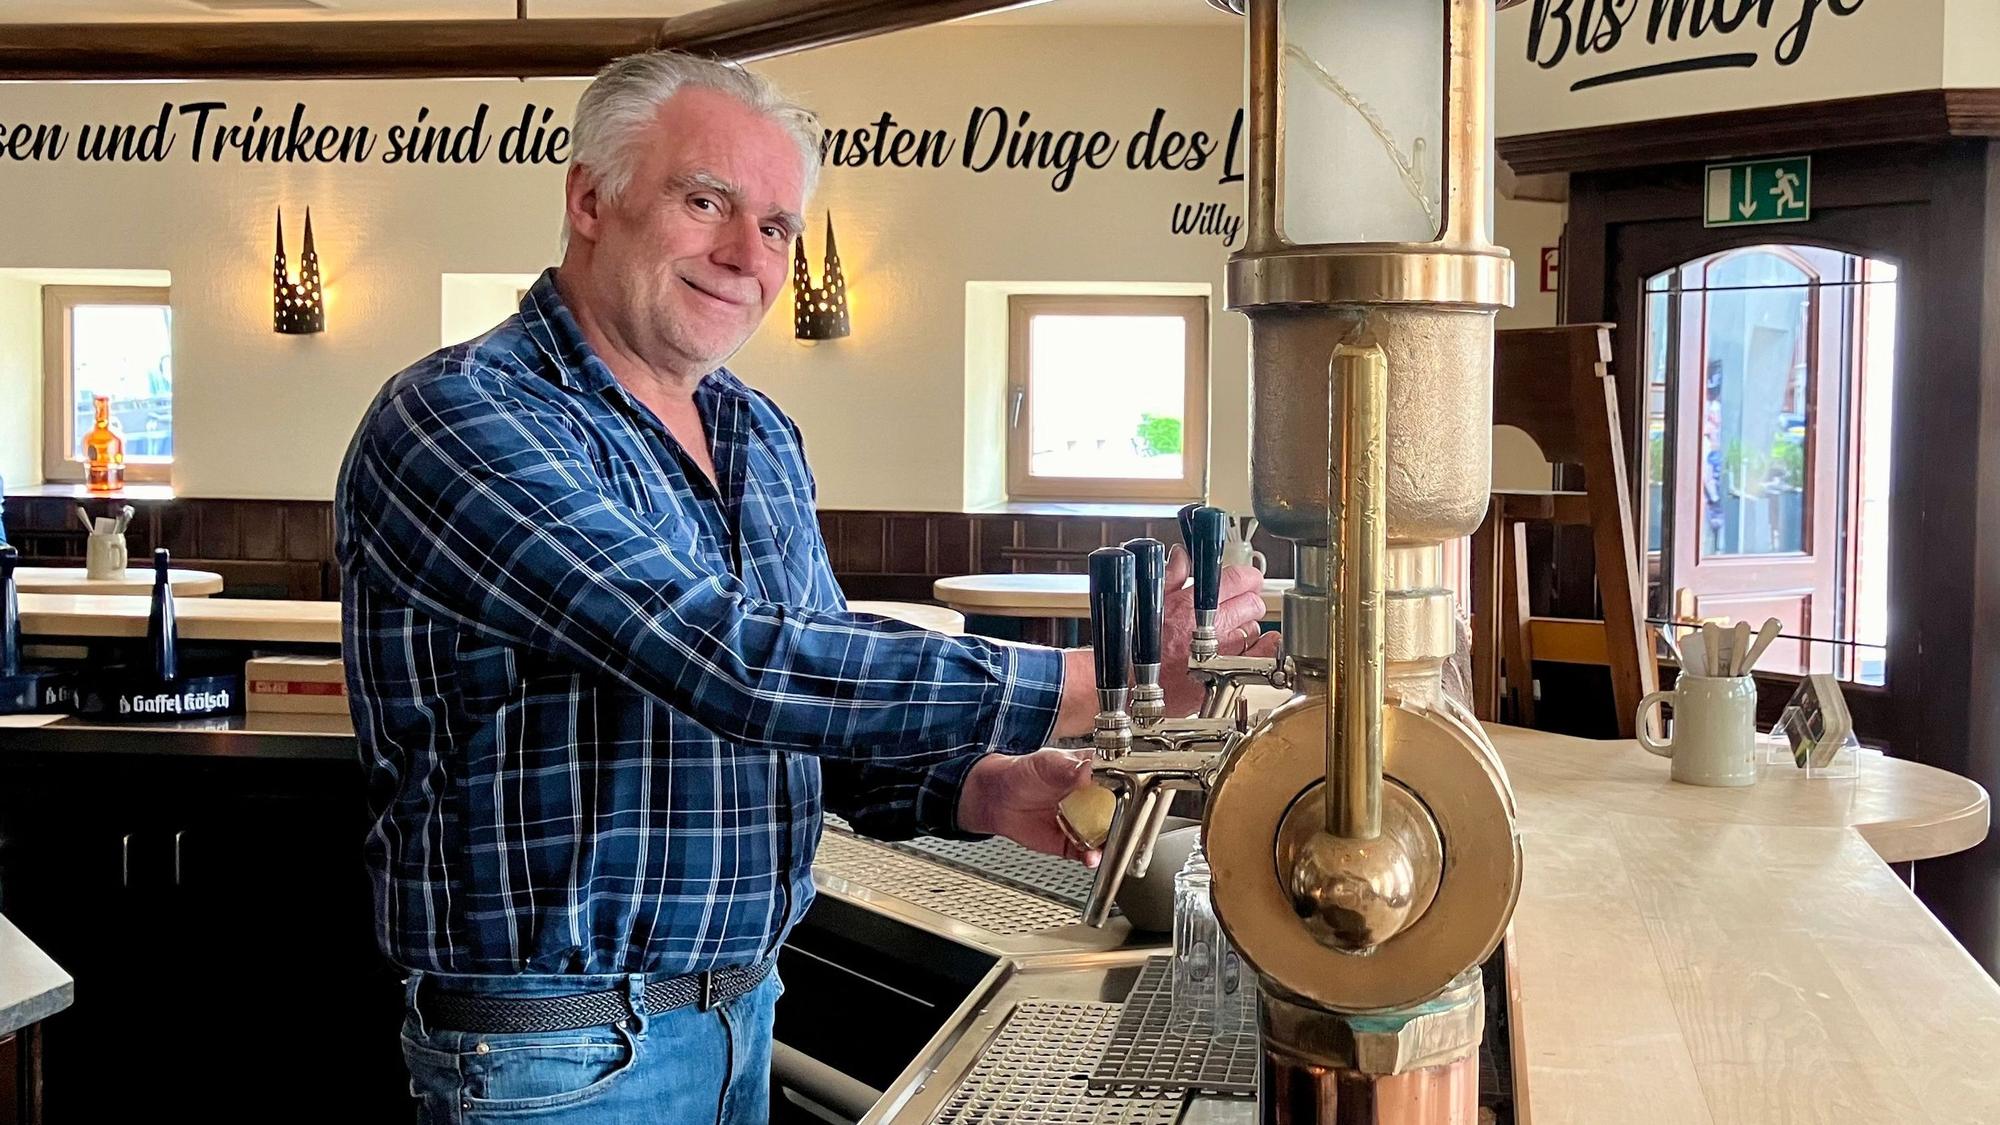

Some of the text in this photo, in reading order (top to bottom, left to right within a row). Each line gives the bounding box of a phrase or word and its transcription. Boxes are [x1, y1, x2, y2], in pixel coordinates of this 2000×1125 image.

[77, 102, 177, 162] und
[179, 102, 377, 163] Trinken
[382, 103, 492, 163] sind
[498, 103, 569, 164] die
[963, 106, 1119, 193] Dinge
[1127, 108, 1218, 171] des
[1172, 202, 1244, 247] Willy
[133, 693, 182, 714] Gaffel
